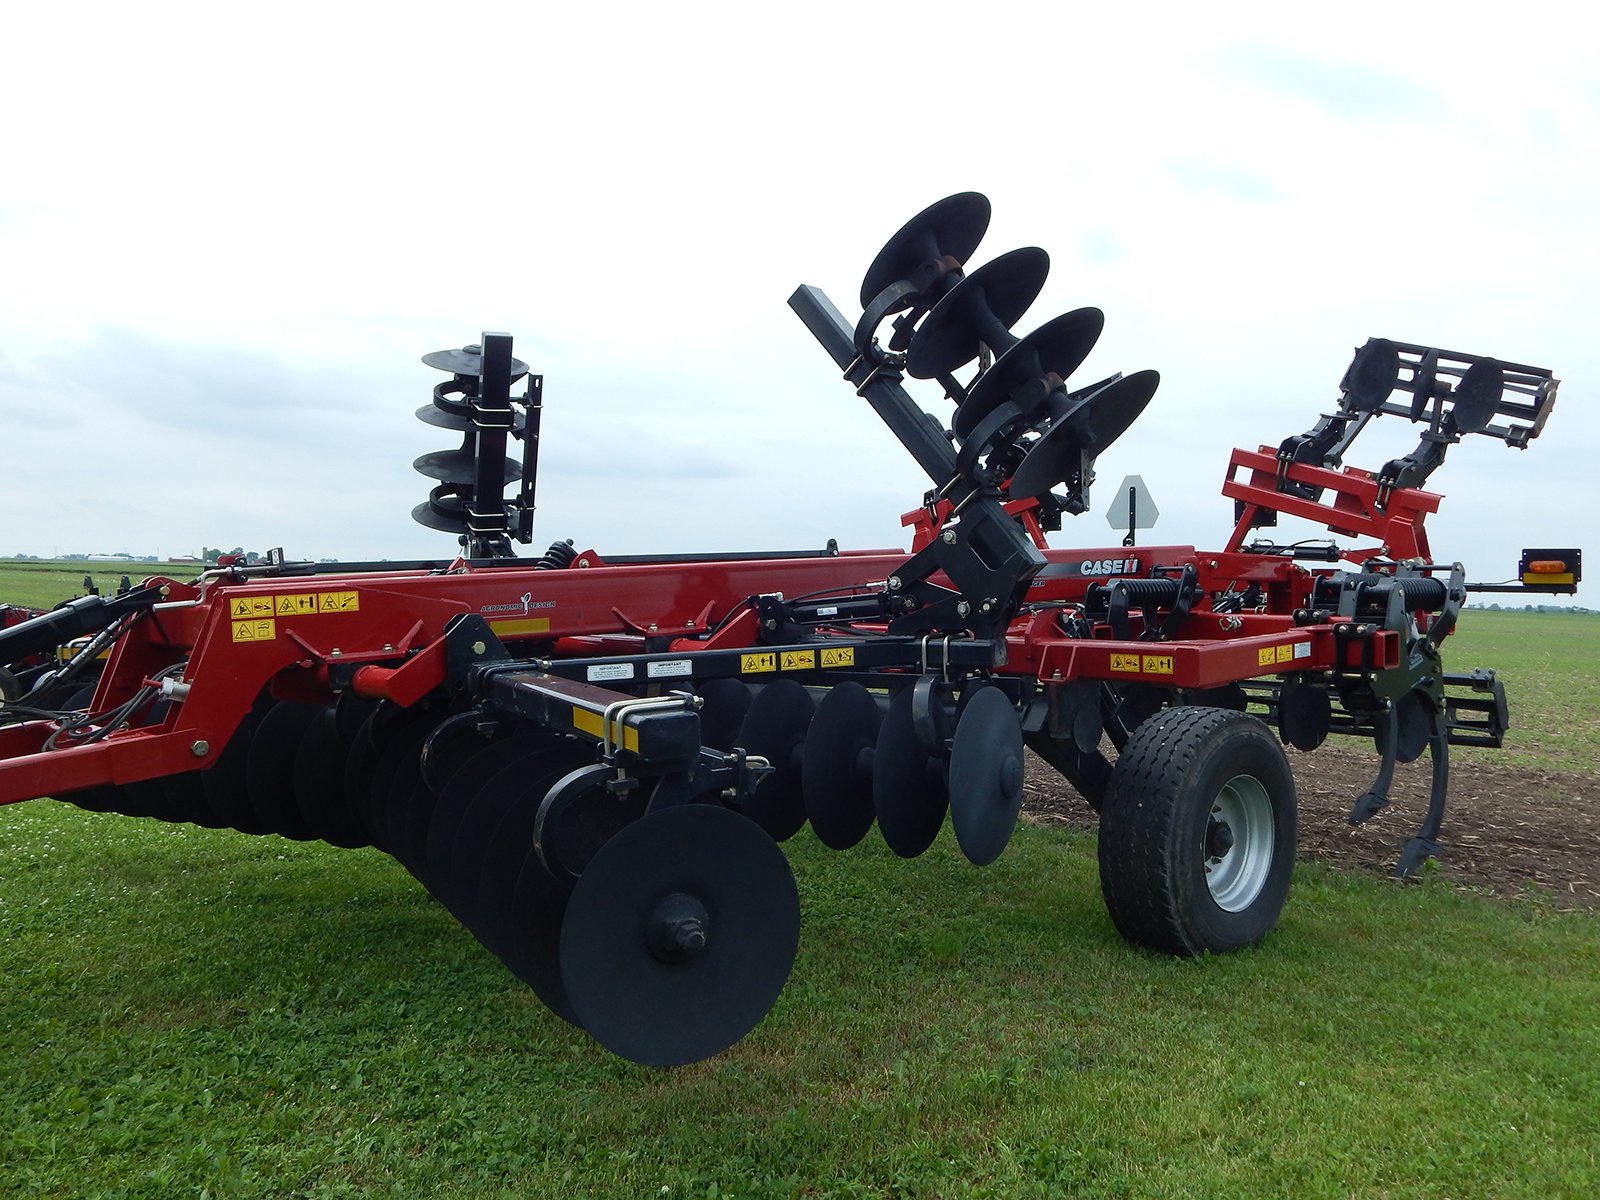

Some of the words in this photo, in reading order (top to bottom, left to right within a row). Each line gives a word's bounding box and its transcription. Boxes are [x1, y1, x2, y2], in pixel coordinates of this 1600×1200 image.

[1080, 560, 1122, 575] CASE
[480, 603, 523, 612] AGRONOMIC
[529, 601, 556, 609] DESIGN
